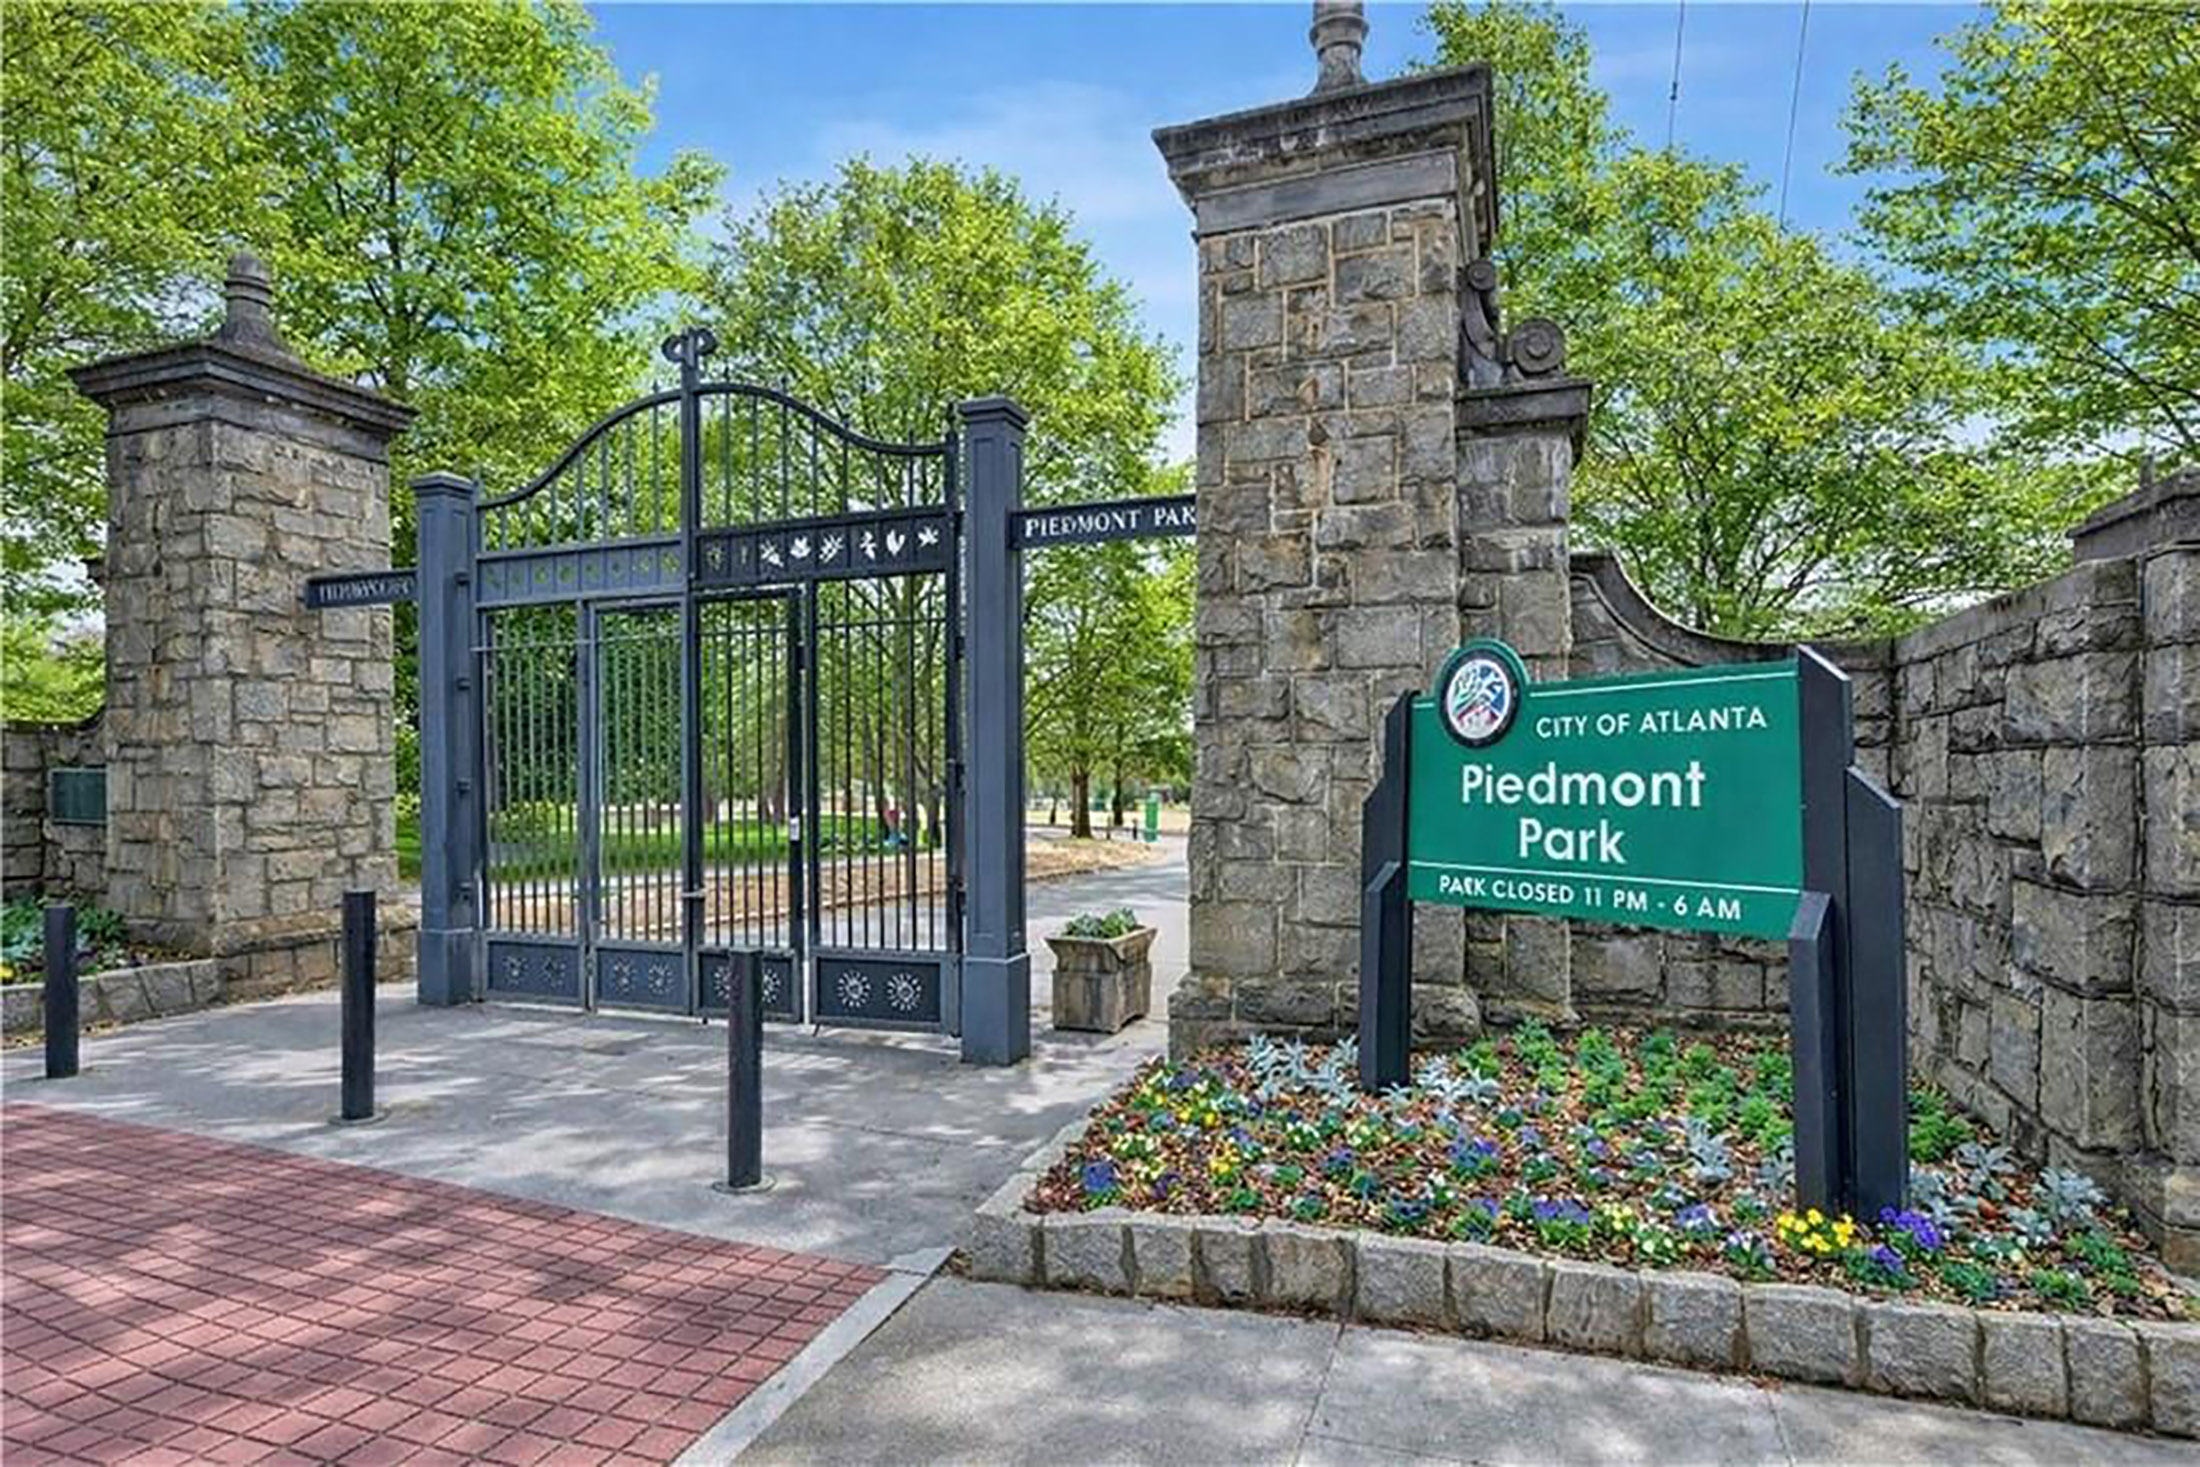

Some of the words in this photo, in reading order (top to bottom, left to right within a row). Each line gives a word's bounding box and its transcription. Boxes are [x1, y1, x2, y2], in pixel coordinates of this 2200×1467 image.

[1025, 510, 1141, 538] PIEDMONT
[1536, 716, 1587, 738] CITY
[1597, 713, 1630, 736] OF
[1639, 705, 1767, 733] ATLANTA
[1462, 761, 1706, 807] Piedmont
[1519, 816, 1626, 864] Park
[1439, 874, 1486, 896] PARK
[1492, 880, 1574, 903] CLOSED
[1584, 887, 1601, 907] 11
[1613, 889, 1648, 912] PM
[1674, 895, 1687, 916] 6
[1697, 896, 1741, 920] AM
